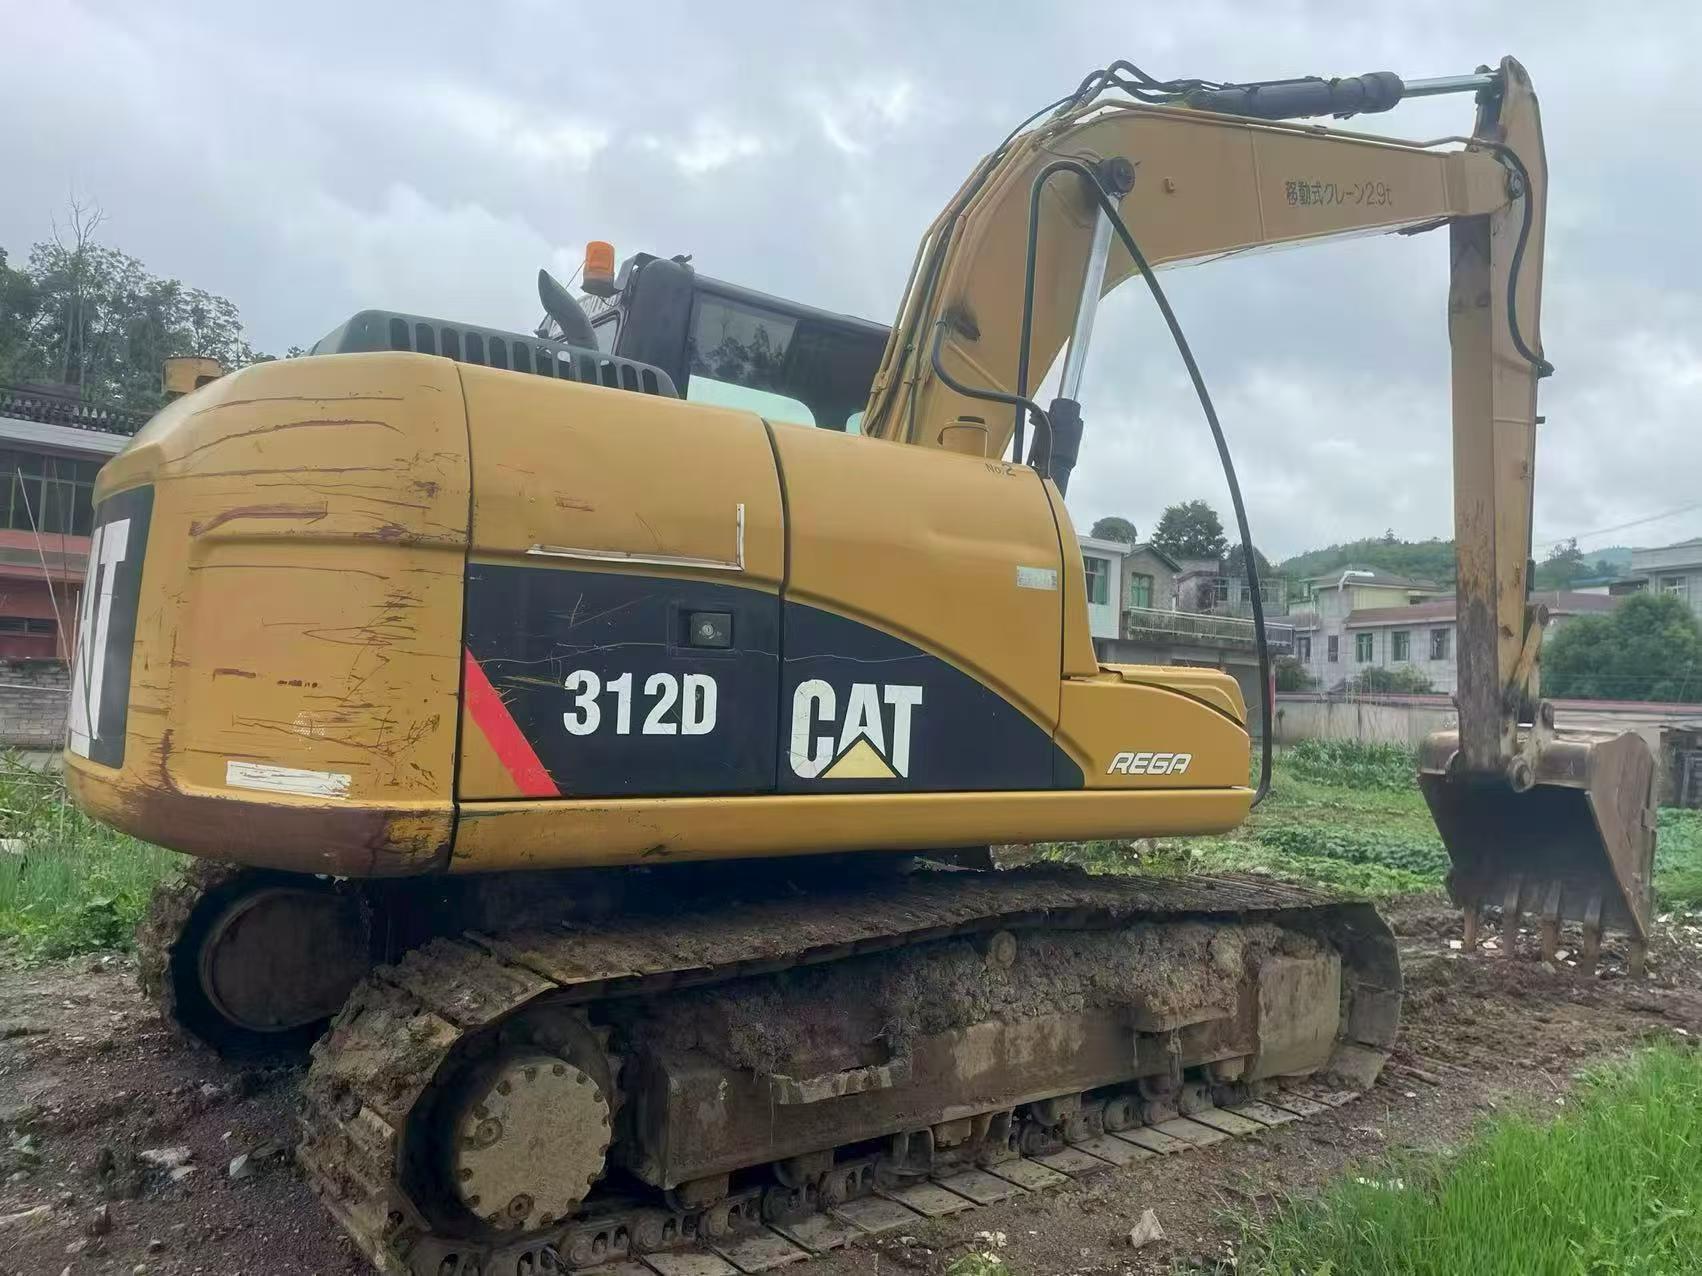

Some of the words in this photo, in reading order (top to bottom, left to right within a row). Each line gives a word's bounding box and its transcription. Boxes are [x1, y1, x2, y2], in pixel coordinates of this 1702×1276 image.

[563, 669, 718, 736] 312D
[789, 679, 923, 779] CAT
[1106, 752, 1192, 775] REGA
